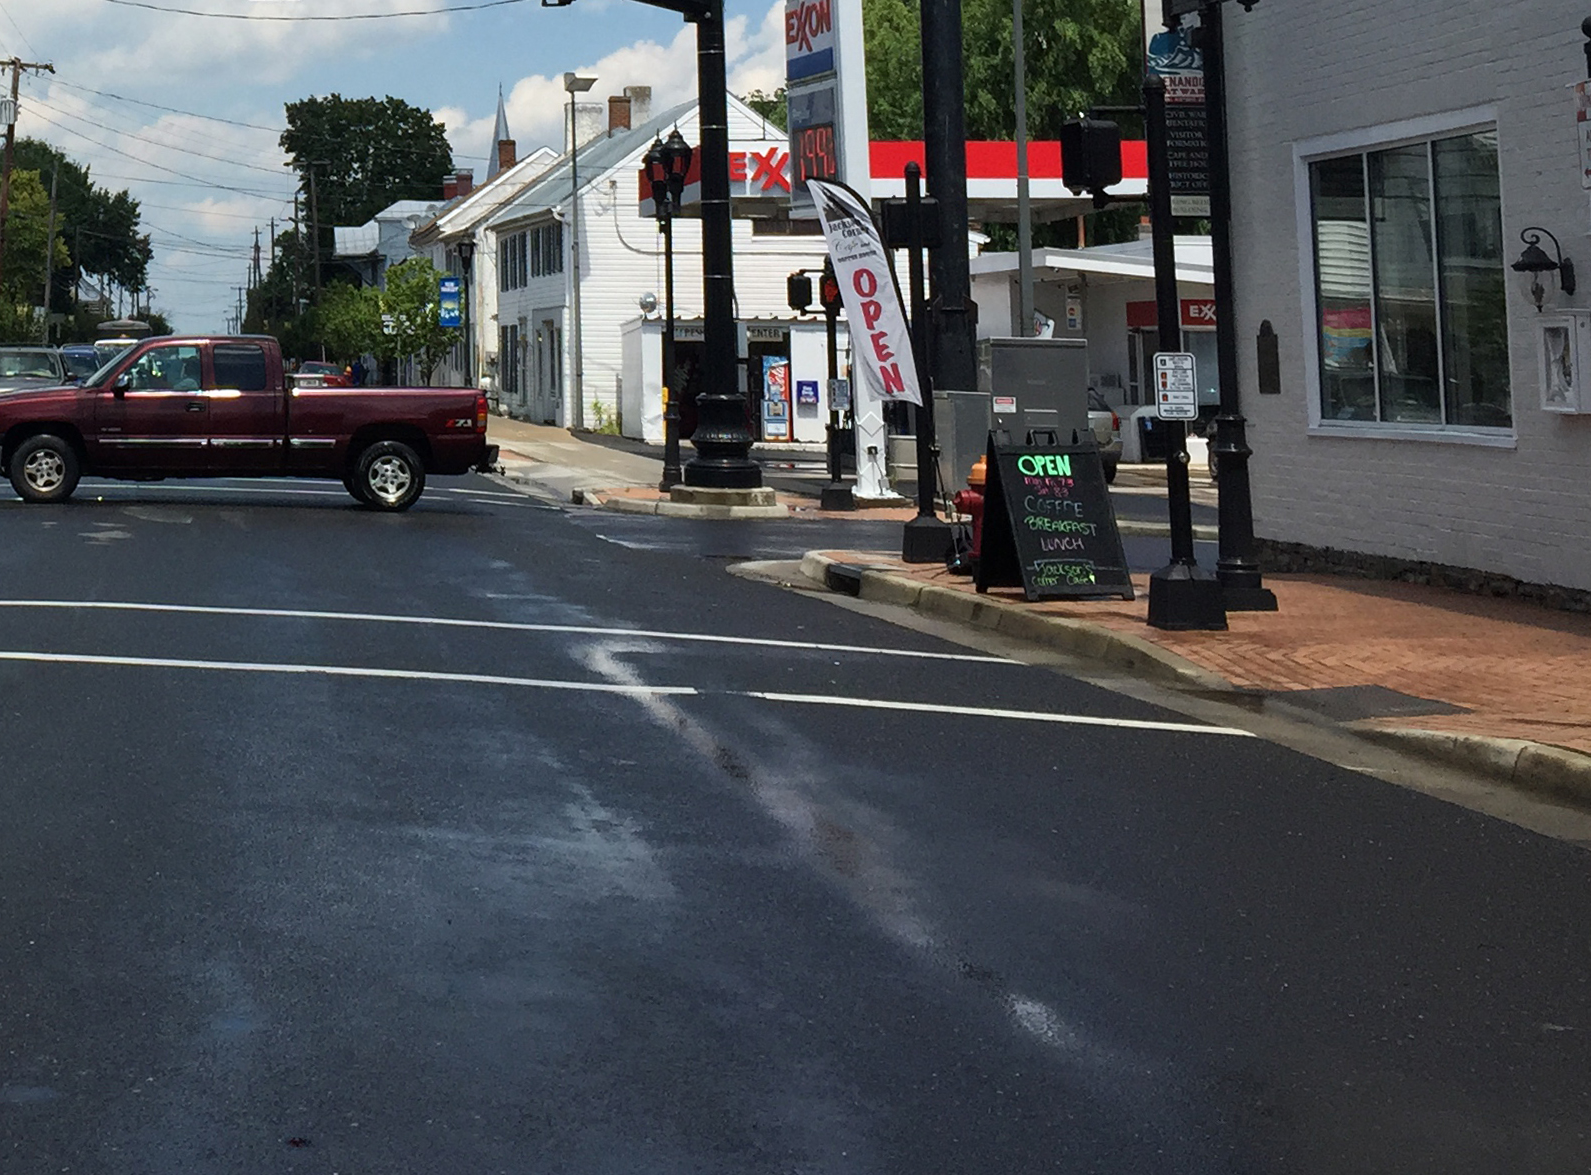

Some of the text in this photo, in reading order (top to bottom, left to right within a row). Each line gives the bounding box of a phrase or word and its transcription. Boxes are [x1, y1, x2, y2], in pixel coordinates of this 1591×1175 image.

[728, 147, 792, 193] EXX
[1189, 304, 1217, 321] EXX
[853, 268, 906, 394] OPEN
[1018, 455, 1072, 477] OPEN
[1024, 516, 1097, 537] BREAKFAST
[1041, 537, 1085, 552] LUNCH
